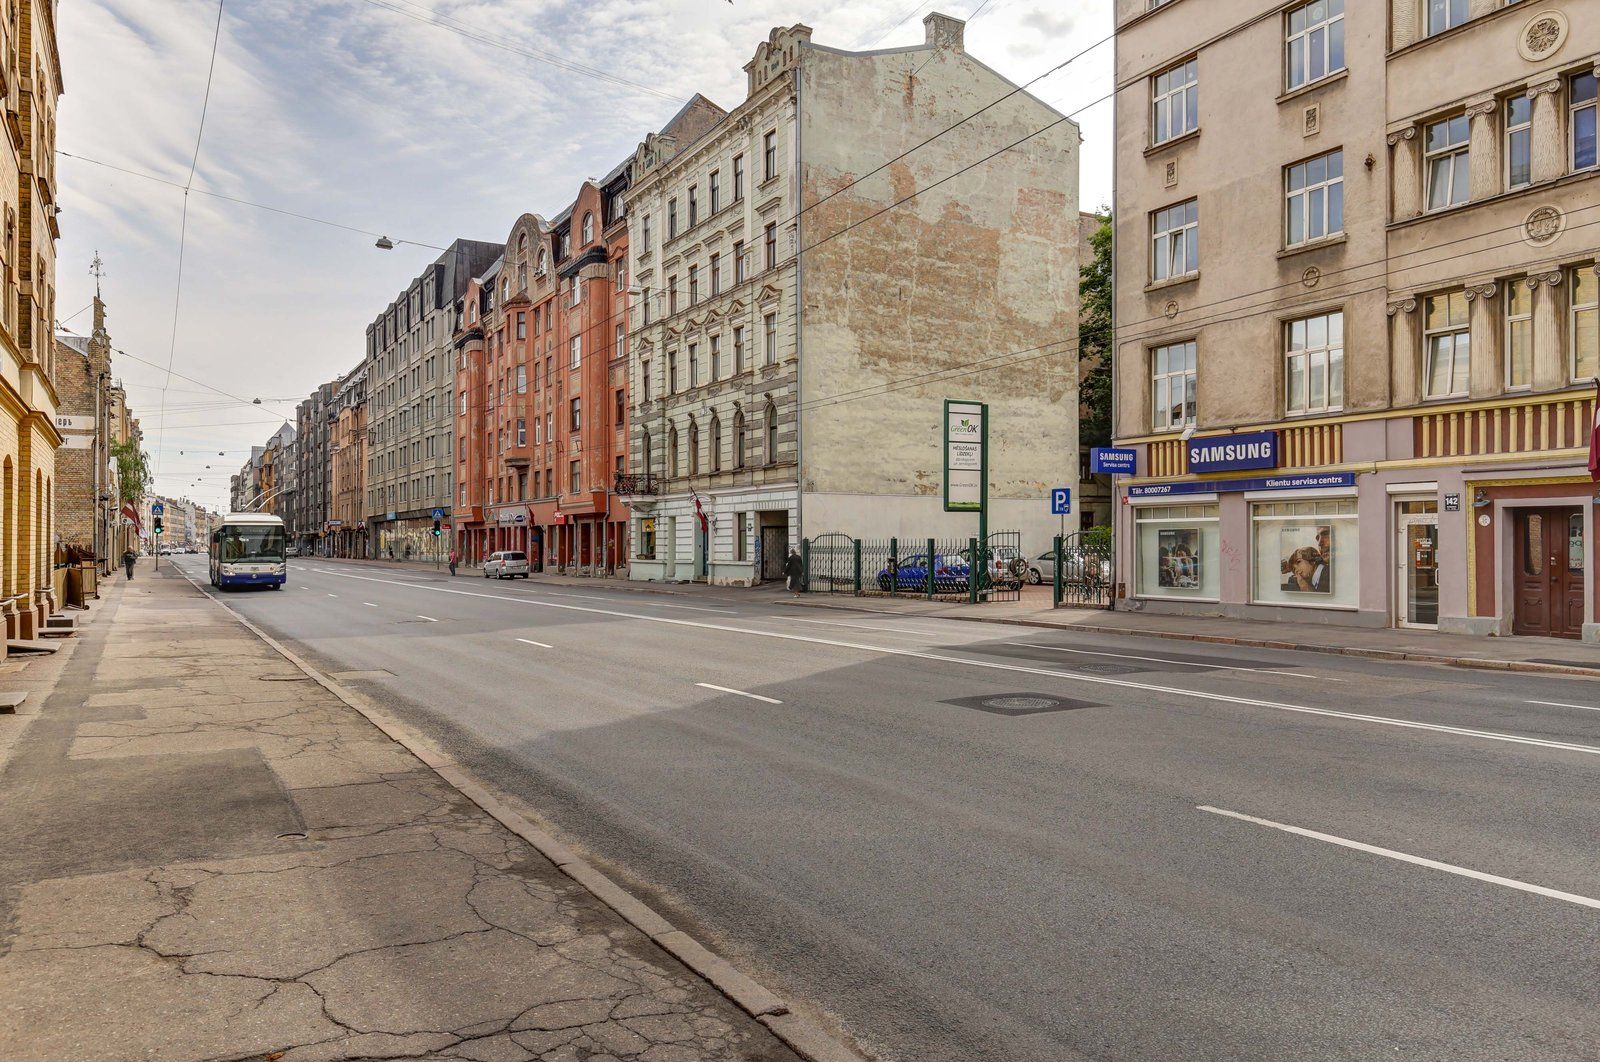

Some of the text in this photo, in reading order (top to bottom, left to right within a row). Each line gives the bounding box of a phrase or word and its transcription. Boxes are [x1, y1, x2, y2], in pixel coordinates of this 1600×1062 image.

[1099, 452, 1134, 462] SAMSUNG
[1190, 441, 1272, 464] SAMSUNG
[1265, 476, 1343, 487] Klientu servisa centrs
[1132, 485, 1171, 495] Tālr. 80007267
[1055, 491, 1066, 511] P
[1445, 497, 1458, 505] 142
